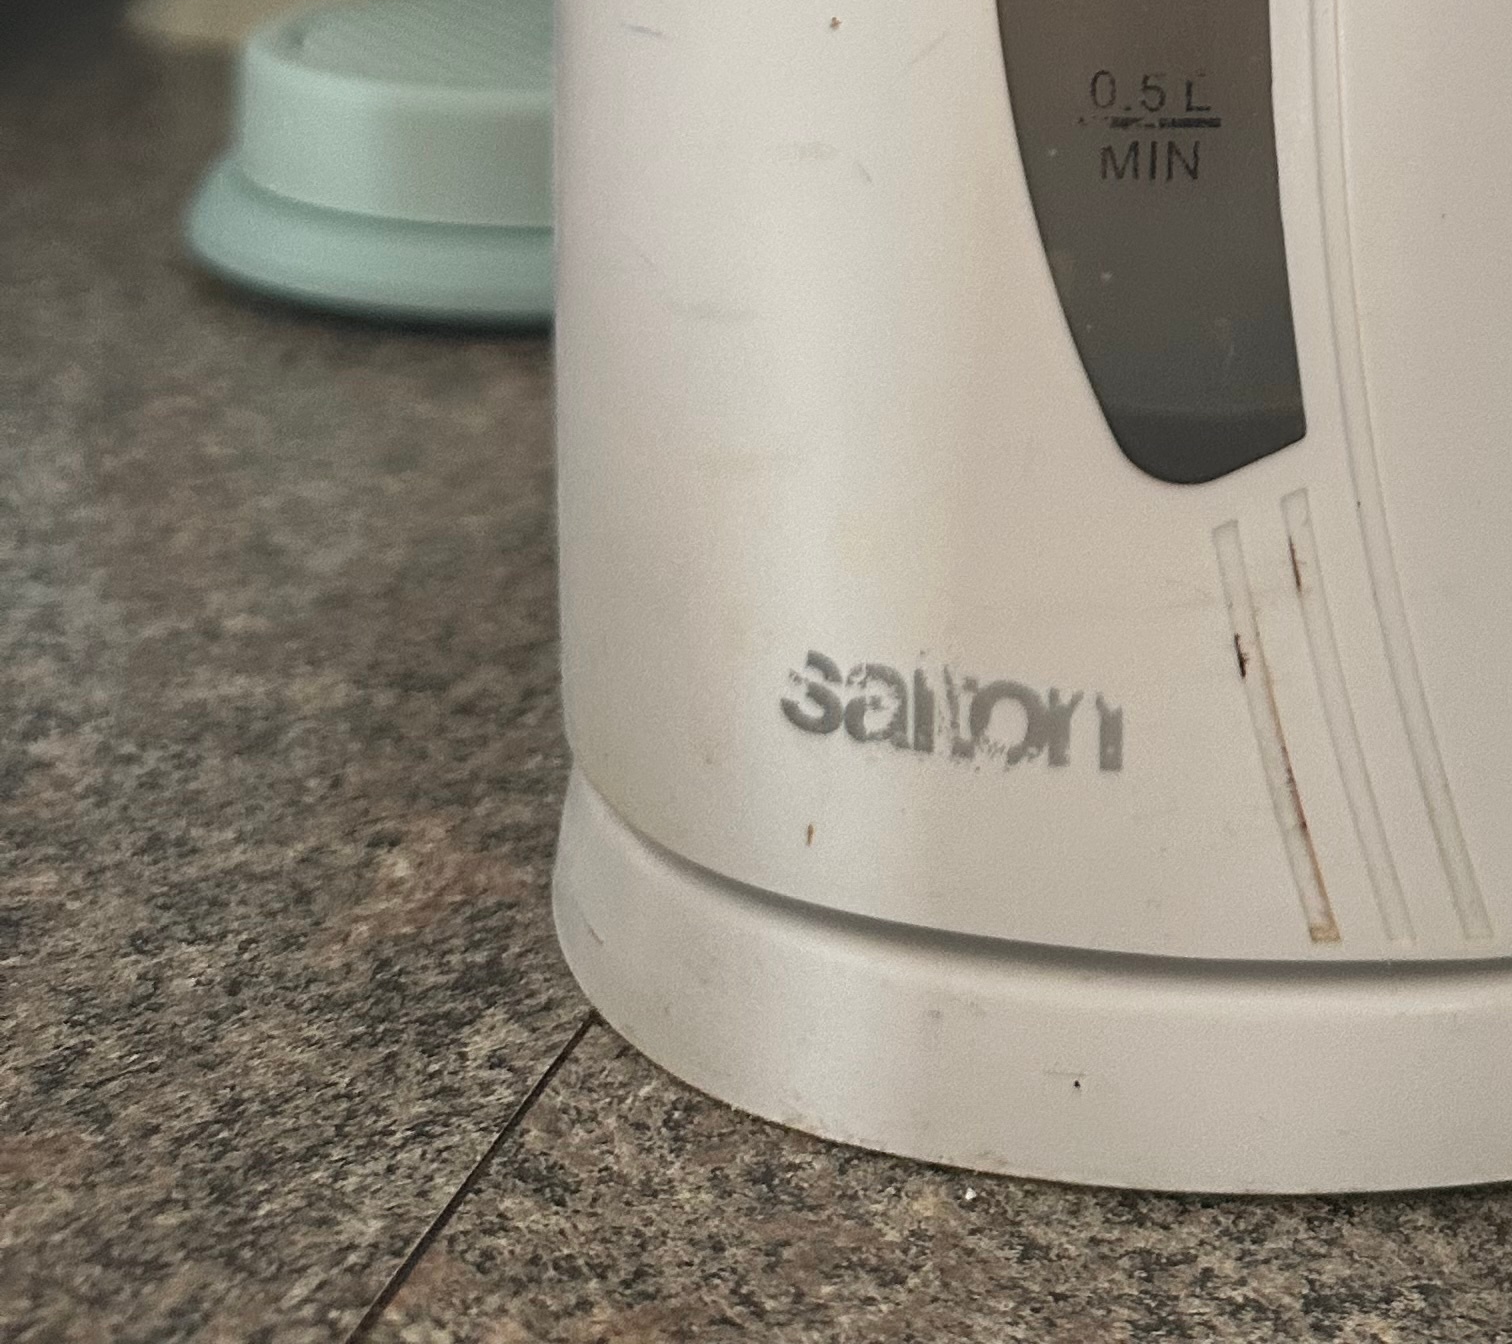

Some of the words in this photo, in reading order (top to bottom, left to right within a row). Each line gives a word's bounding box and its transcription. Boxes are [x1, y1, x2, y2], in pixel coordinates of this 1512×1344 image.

[1090, 69, 1167, 113] 0.5
[1185, 79, 1212, 113] L
[1100, 140, 1201, 182] MIN
